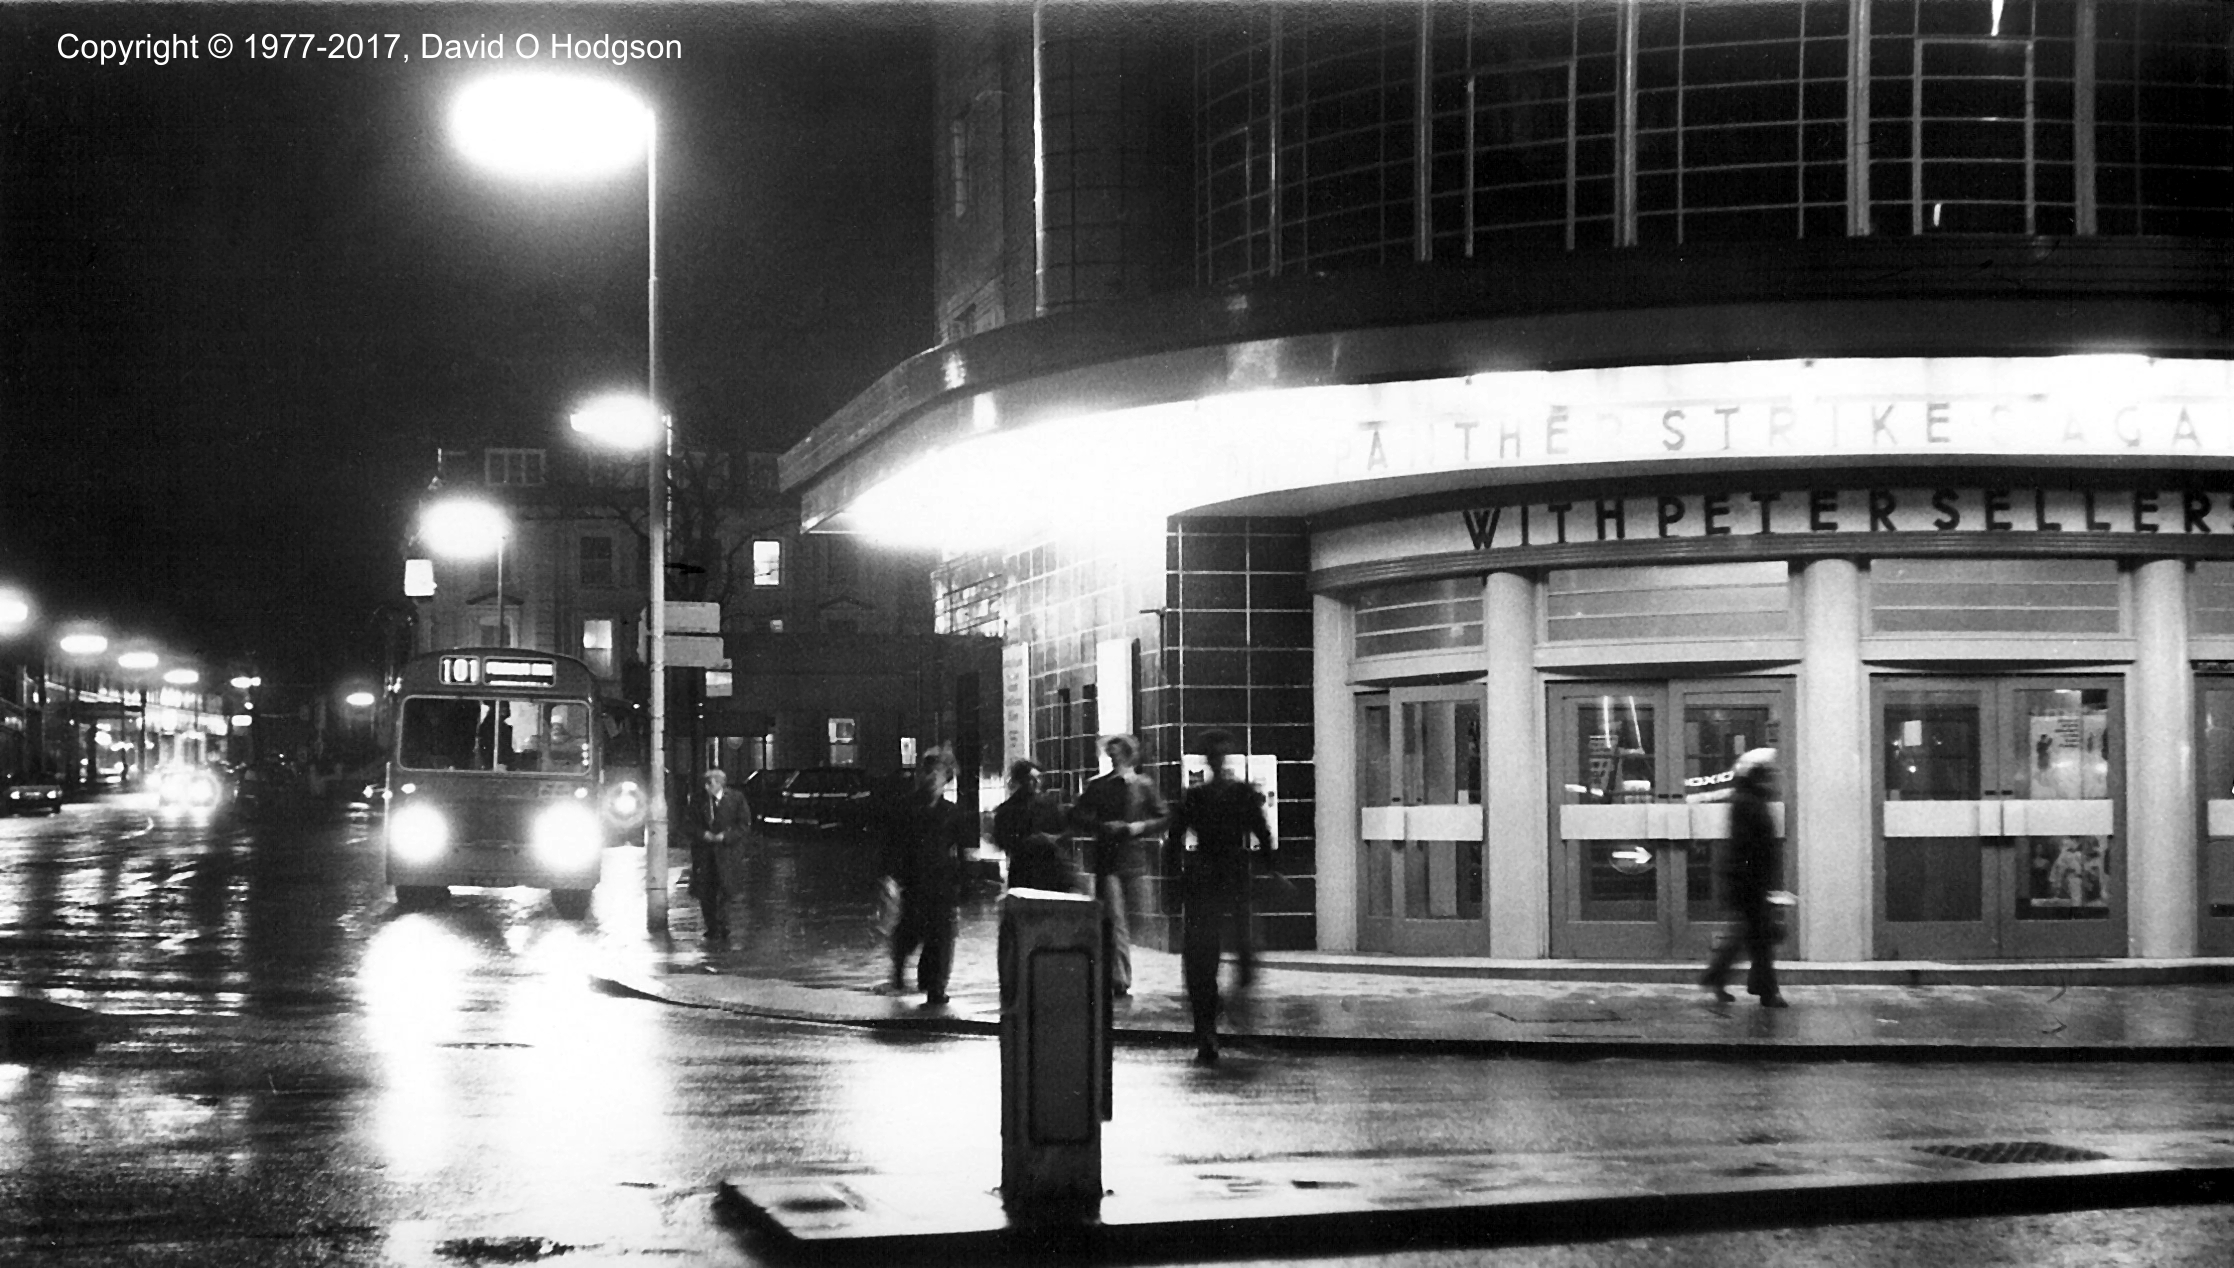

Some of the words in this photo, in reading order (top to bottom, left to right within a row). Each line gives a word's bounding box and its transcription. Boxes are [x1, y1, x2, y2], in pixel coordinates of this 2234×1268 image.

[2062, 405, 2233, 449] AGA
[1462, 498, 1625, 550] WITH
[1657, 490, 1897, 540] PETER
[1931, 489, 2234, 533] SELLER
[443, 658, 480, 684] 101
